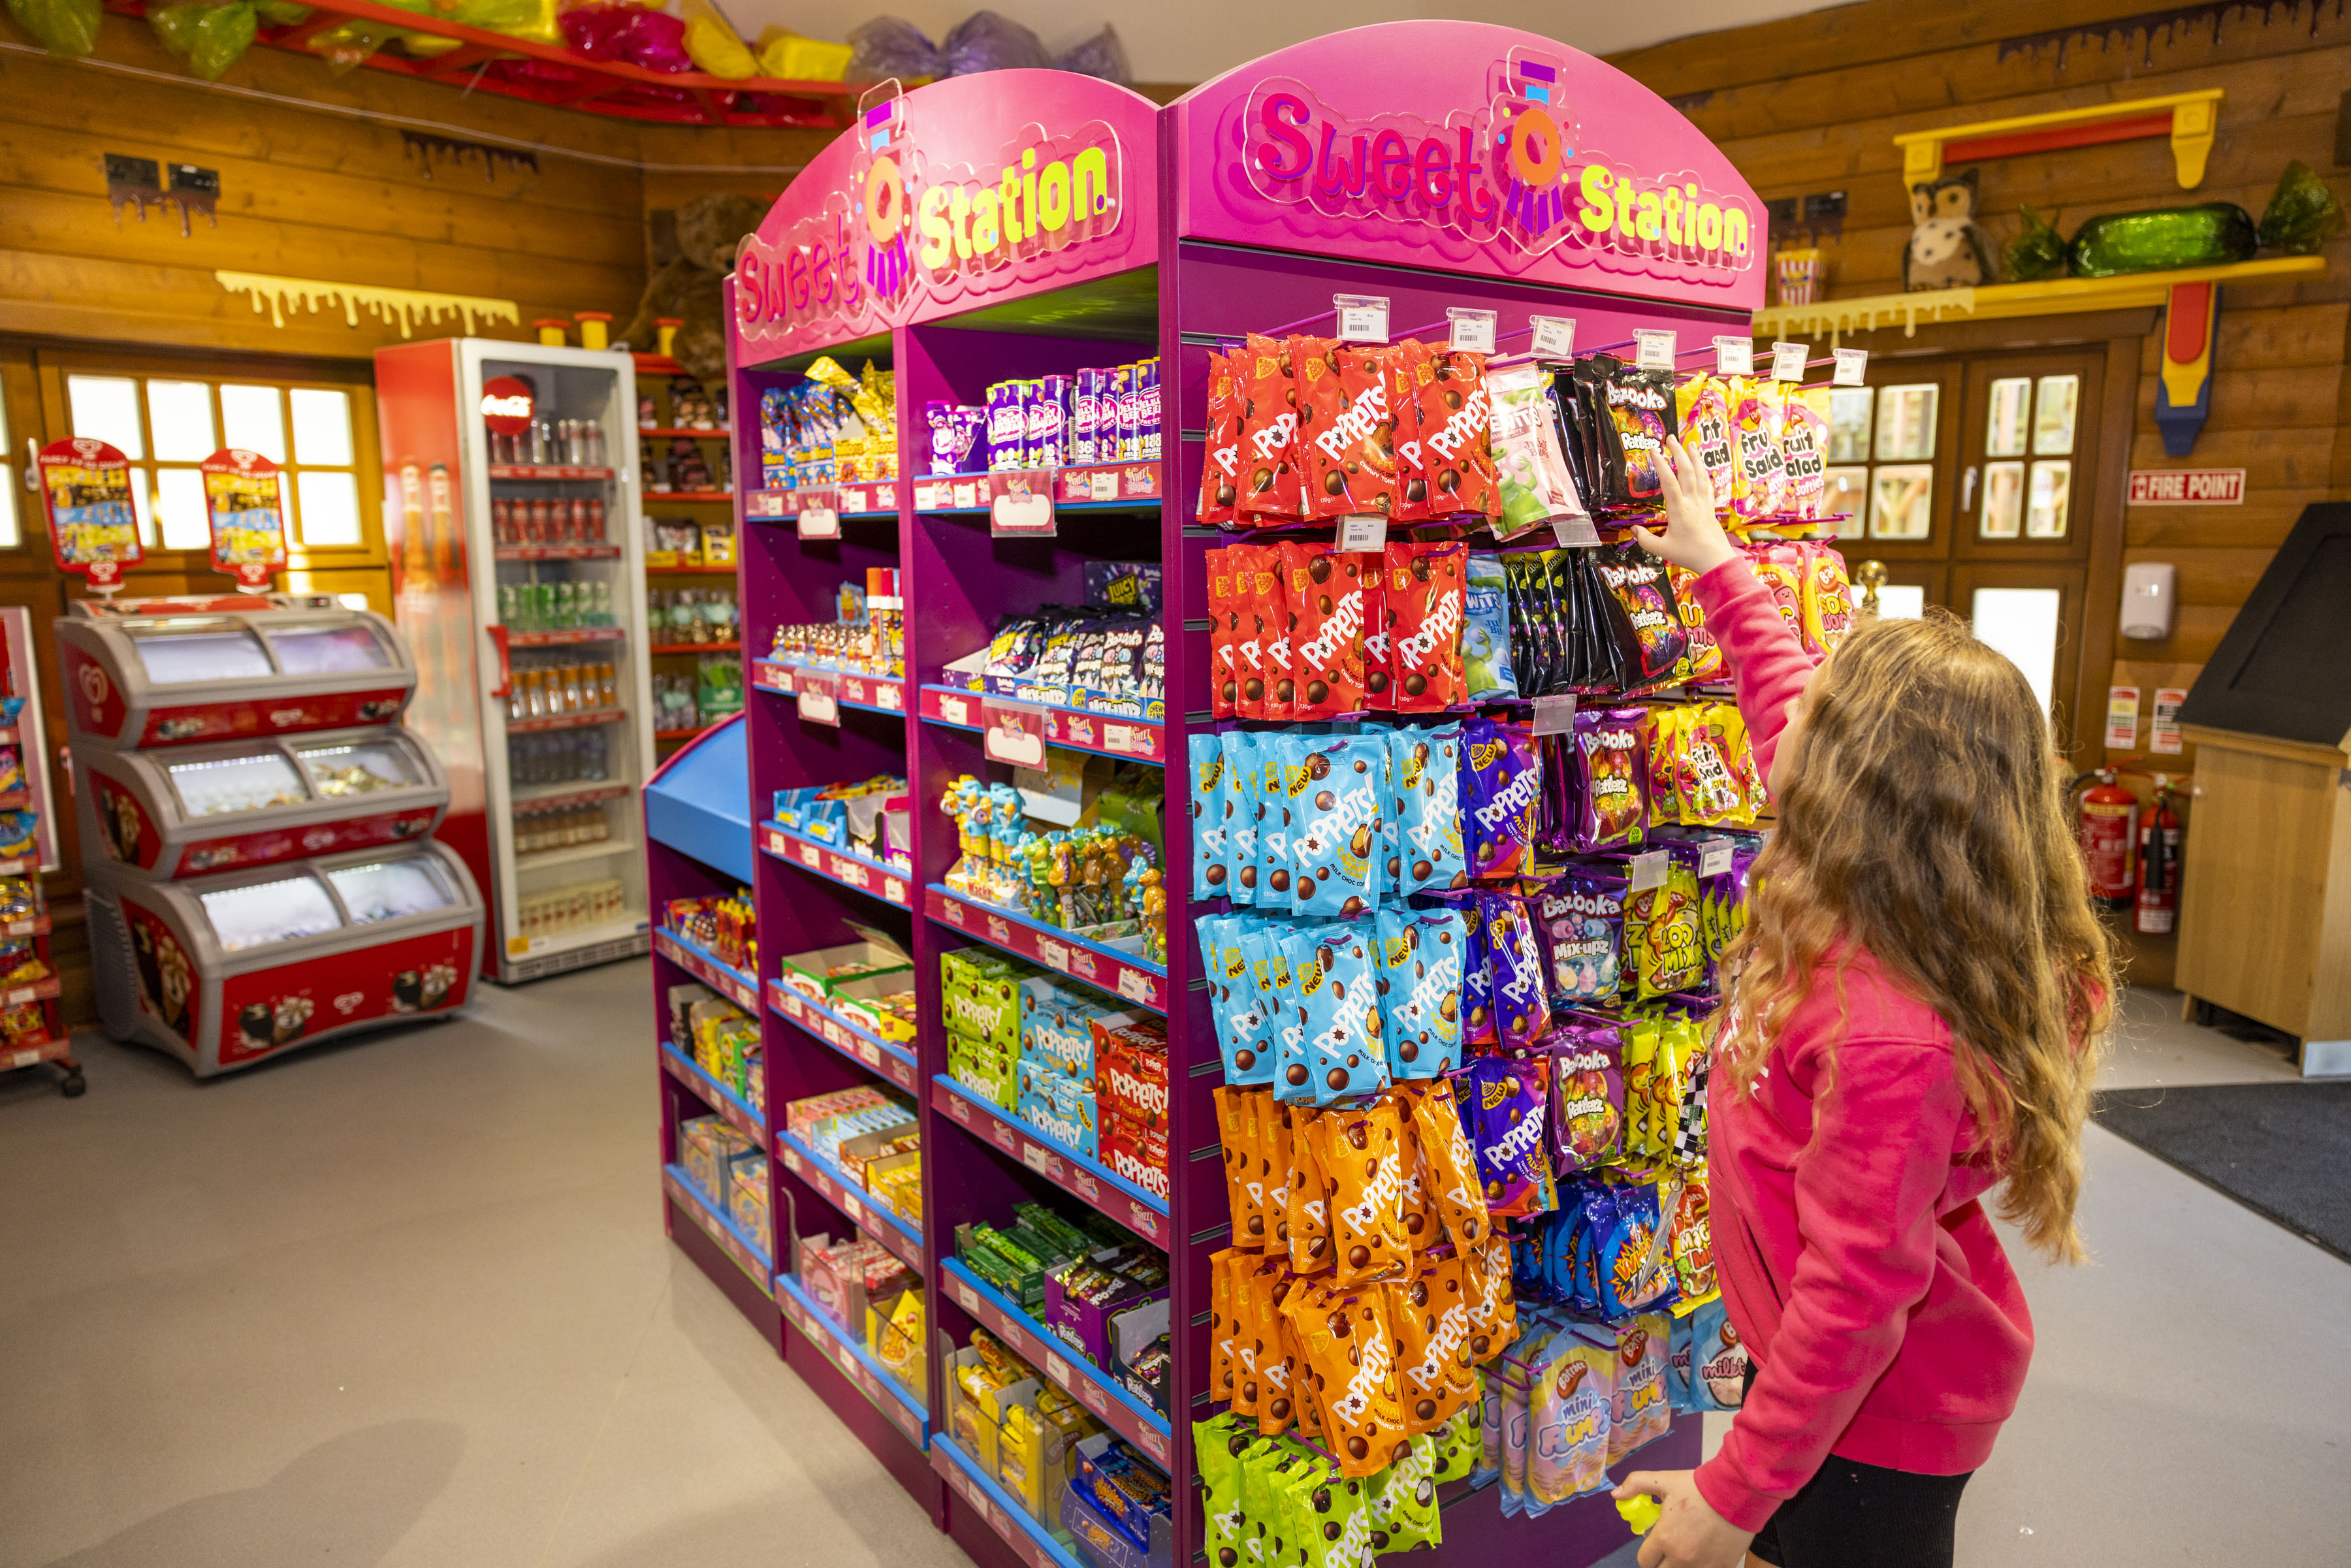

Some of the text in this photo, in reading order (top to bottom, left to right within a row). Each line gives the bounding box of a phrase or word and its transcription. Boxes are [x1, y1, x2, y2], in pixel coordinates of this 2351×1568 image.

[1256, 92, 1749, 255] Sweet Station
[739, 146, 1108, 323] Sweet Station
[1607, 379, 1667, 409] Bazooka
[1078, 440, 1093, 453] 36
[1130, 466, 1151, 487] SWEET
[1360, 461, 1379, 478] CHEWY
[2147, 474, 2239, 500] FIRE POINT
[1546, 552, 1562, 570] new
[1108, 577, 1136, 600] JUICY
[1104, 629, 1143, 650] Bazooka
[1474, 746, 1495, 770] NEW
[1202, 763, 1223, 793] NEW
[1287, 769, 1310, 797] NEW
[1595, 775, 1628, 797] Rattlerz
[1439, 844, 1451, 855] MILK
[1330, 863, 1356, 886] MILK CHOC
[1542, 893, 1621, 918] Bazooka
[1390, 938, 1410, 967] NEW
[1554, 939, 1609, 961] Mix-upz
[1663, 946, 1697, 974] MIX
[1304, 961, 1324, 995] NEW
[1485, 1084, 1505, 1108] NEW
[1567, 1095, 1605, 1120] Rattlerz
[1445, 1373, 1456, 1385] MILK
[1558, 1360, 1586, 1390] Barratt
[1629, 1360, 1656, 1386] mini
[1444, 1381, 1462, 1394] ORANGE
[1373, 1407, 1385, 1420] MILK
[1562, 1392, 1593, 1420] mini
[1374, 1416, 1396, 1431] ORANGE
[1402, 1510, 1413, 1522] DARK
